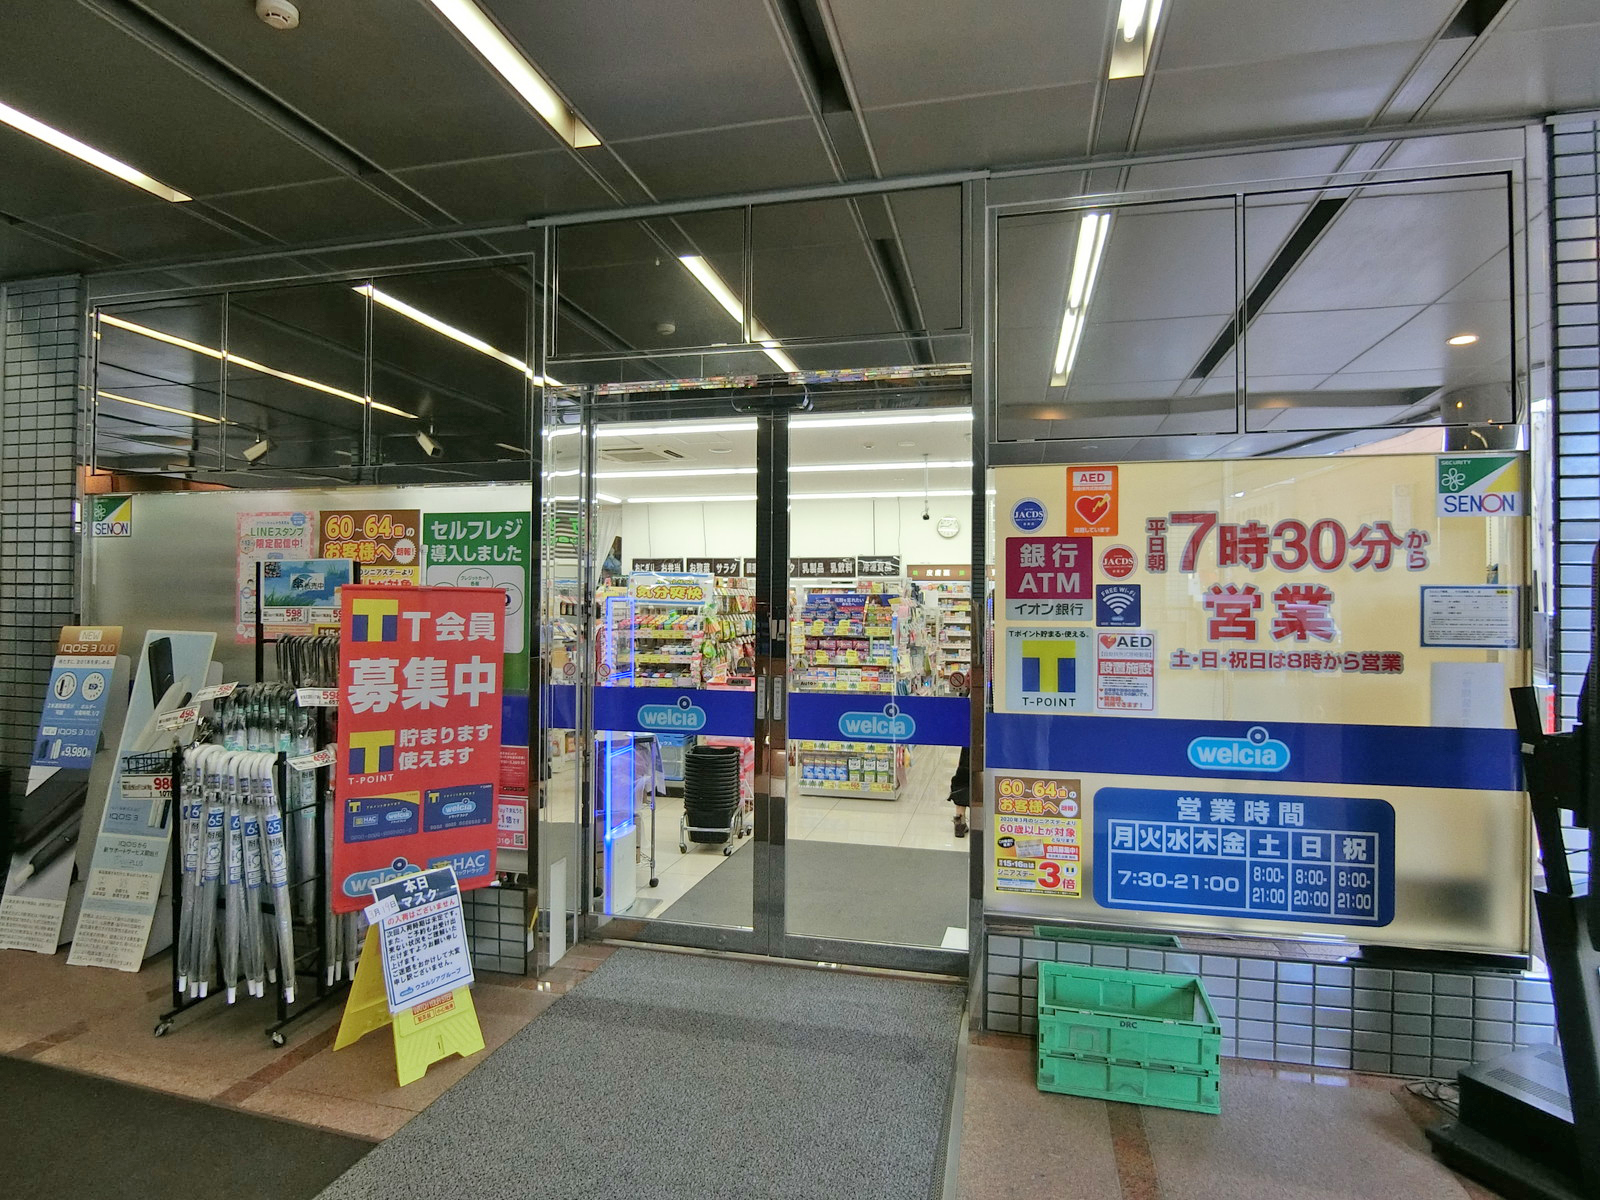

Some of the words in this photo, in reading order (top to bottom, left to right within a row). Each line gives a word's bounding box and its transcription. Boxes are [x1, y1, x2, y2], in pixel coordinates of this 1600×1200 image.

[1080, 473, 1106, 482] AED
[1443, 494, 1515, 513] SENON
[1014, 511, 1044, 519] JACDS
[95, 522, 128, 535] SENON
[431, 518, 523, 540] セルフレジ
[325, 540, 392, 563] お客様へ
[431, 545, 522, 563] 導入しました
[1147, 519, 1166, 572] 平日朝
[1019, 543, 1079, 568] 銀行
[1103, 558, 1134, 566] JACDS
[715, 562, 738, 574] サラダ
[1018, 572, 1080, 593] ATM
[1100, 586, 1118, 597] FREE
[1119, 587, 1137, 597] Wi-Fi
[285, 609, 302, 617] 598
[333, 609, 342, 617] 59
[1014, 603, 1084, 616] イオン銀行
[1205, 585, 1335, 641] 営業
[60, 644, 89, 653] IQOS
[90, 643, 97, 652] 3
[1116, 636, 1152, 648] AED
[347, 655, 497, 715] 募集中
[1022, 697, 1076, 707] T-POINT
[643, 708, 698, 726] welcia
[845, 716, 906, 735] welcia
[57, 728, 78, 736] IQOS
[399, 723, 493, 748] 貯まります
[398, 746, 474, 771] 使えます
[1196, 743, 1277, 766] welcia
[347, 773, 395, 785] T-POINT
[192, 806, 201, 818] 6
[445, 803, 473, 813] welcia
[999, 797, 1059, 815] お客様へ
[1176, 797, 1305, 827] 営業時間
[208, 814, 223, 827] 65
[232, 817, 240, 829] 6
[267, 822, 281, 833] 65
[999, 824, 1076, 837] 60歳以上が対象
[1113, 827, 1133, 848] 月
[1139, 827, 1162, 849] 火
[1167, 828, 1190, 850] 水
[1194, 830, 1218, 852] 木
[1222, 832, 1246, 855] 金
[1258, 834, 1281, 857] 土
[1301, 836, 1322, 859] 日
[1342, 838, 1367, 861] 祝
[453, 855, 486, 871] HAC
[403, 875, 429, 893] 本日
[1038, 861, 1061, 889] 3
[1062, 878, 1076, 890] 倍
[1117, 869, 1240, 893] 7:30-21:00
[1253, 866, 1285, 882] 8:00-
[1295, 869, 1328, 885] 8:00-
[1338, 872, 1371, 888] 8:00-
[401, 889, 437, 908] マスク
[1252, 887, 1285, 904] 21:00
[1293, 891, 1329, 908] 20:00
[1337, 893, 1371, 910] 21:00
[387, 899, 456, 926] の入荷はございません
